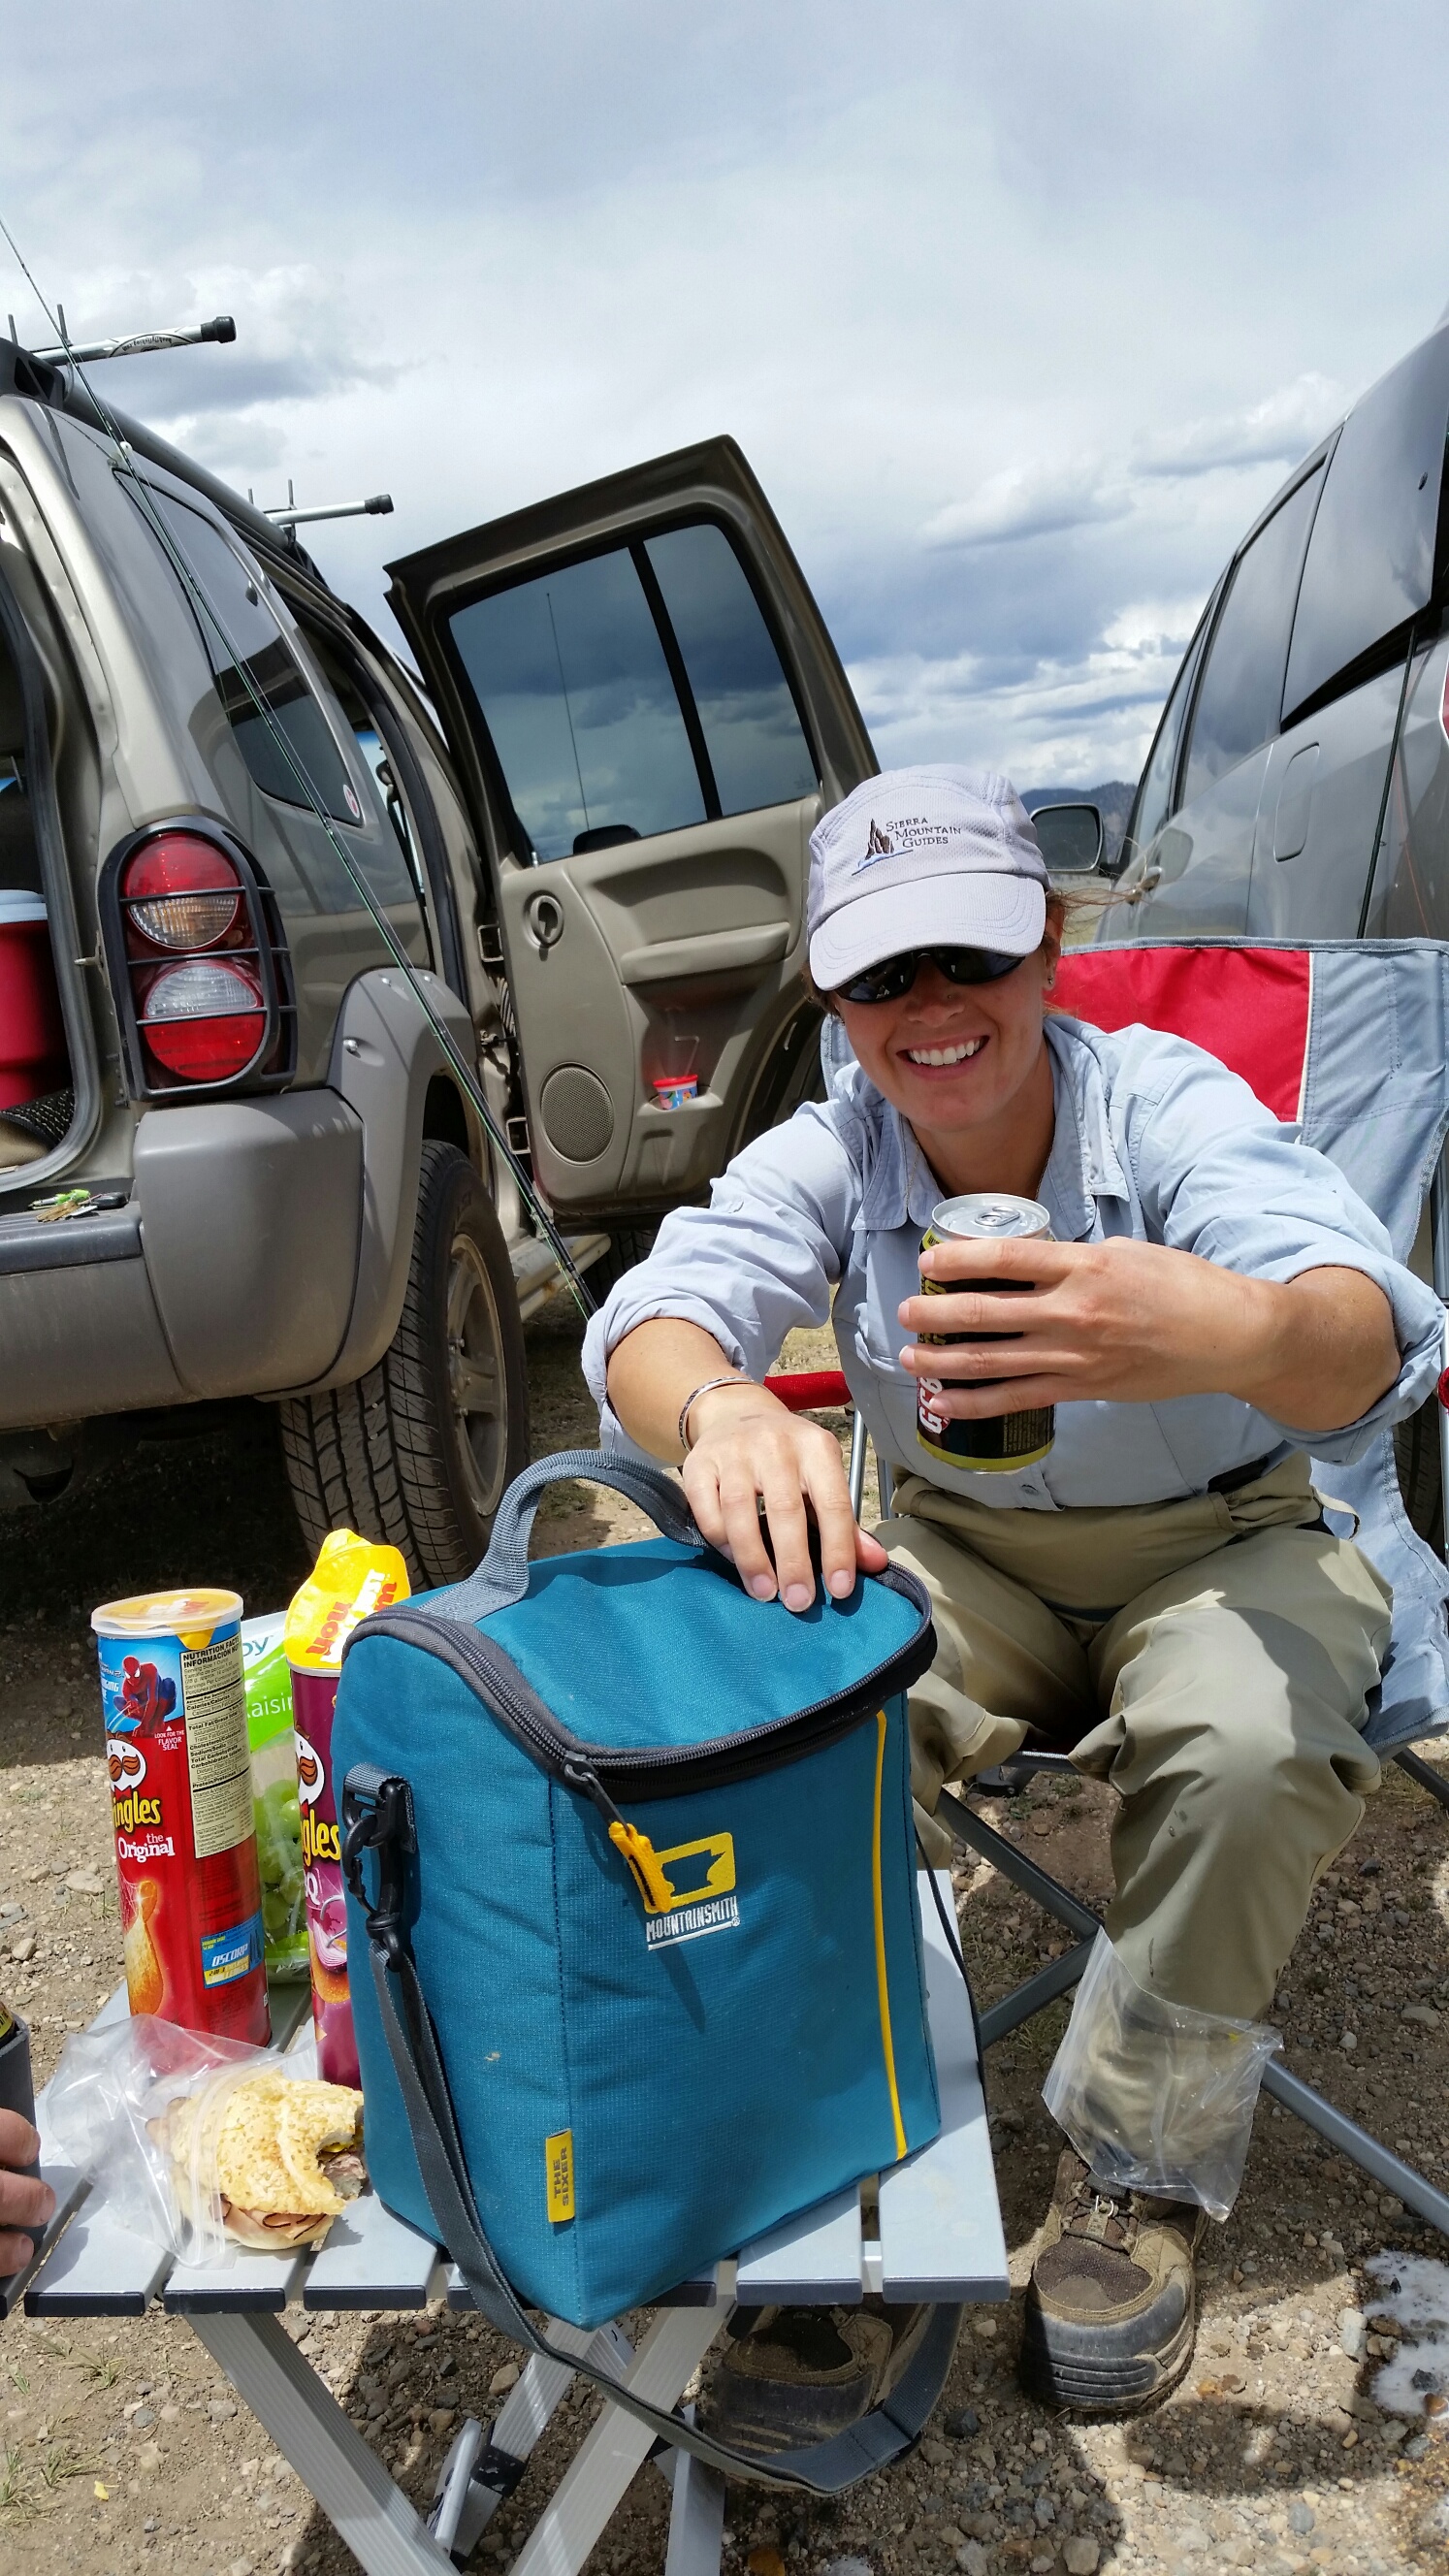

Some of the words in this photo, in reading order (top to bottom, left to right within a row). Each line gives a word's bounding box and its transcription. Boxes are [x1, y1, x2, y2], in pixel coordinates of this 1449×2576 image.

[886, 818, 928, 832] SIERRA
[894, 826, 961, 840] MOUNTAIN
[902, 836, 949, 848] GUIDES
[306, 1601, 352, 1656] you
[183, 1644, 225, 1661] NUTRITION
[183, 1650, 231, 1669] INFORMACION
[158, 1736, 182, 1746] FLAVOR
[145, 1832, 164, 1844] the
[117, 1836, 176, 1863] Original
[646, 1895, 739, 1942] MOUNTAINSMITH
[211, 1943, 248, 1968] OSCORP
[553, 2158, 562, 2200] THE
[561, 2146, 569, 2206] SIXER
